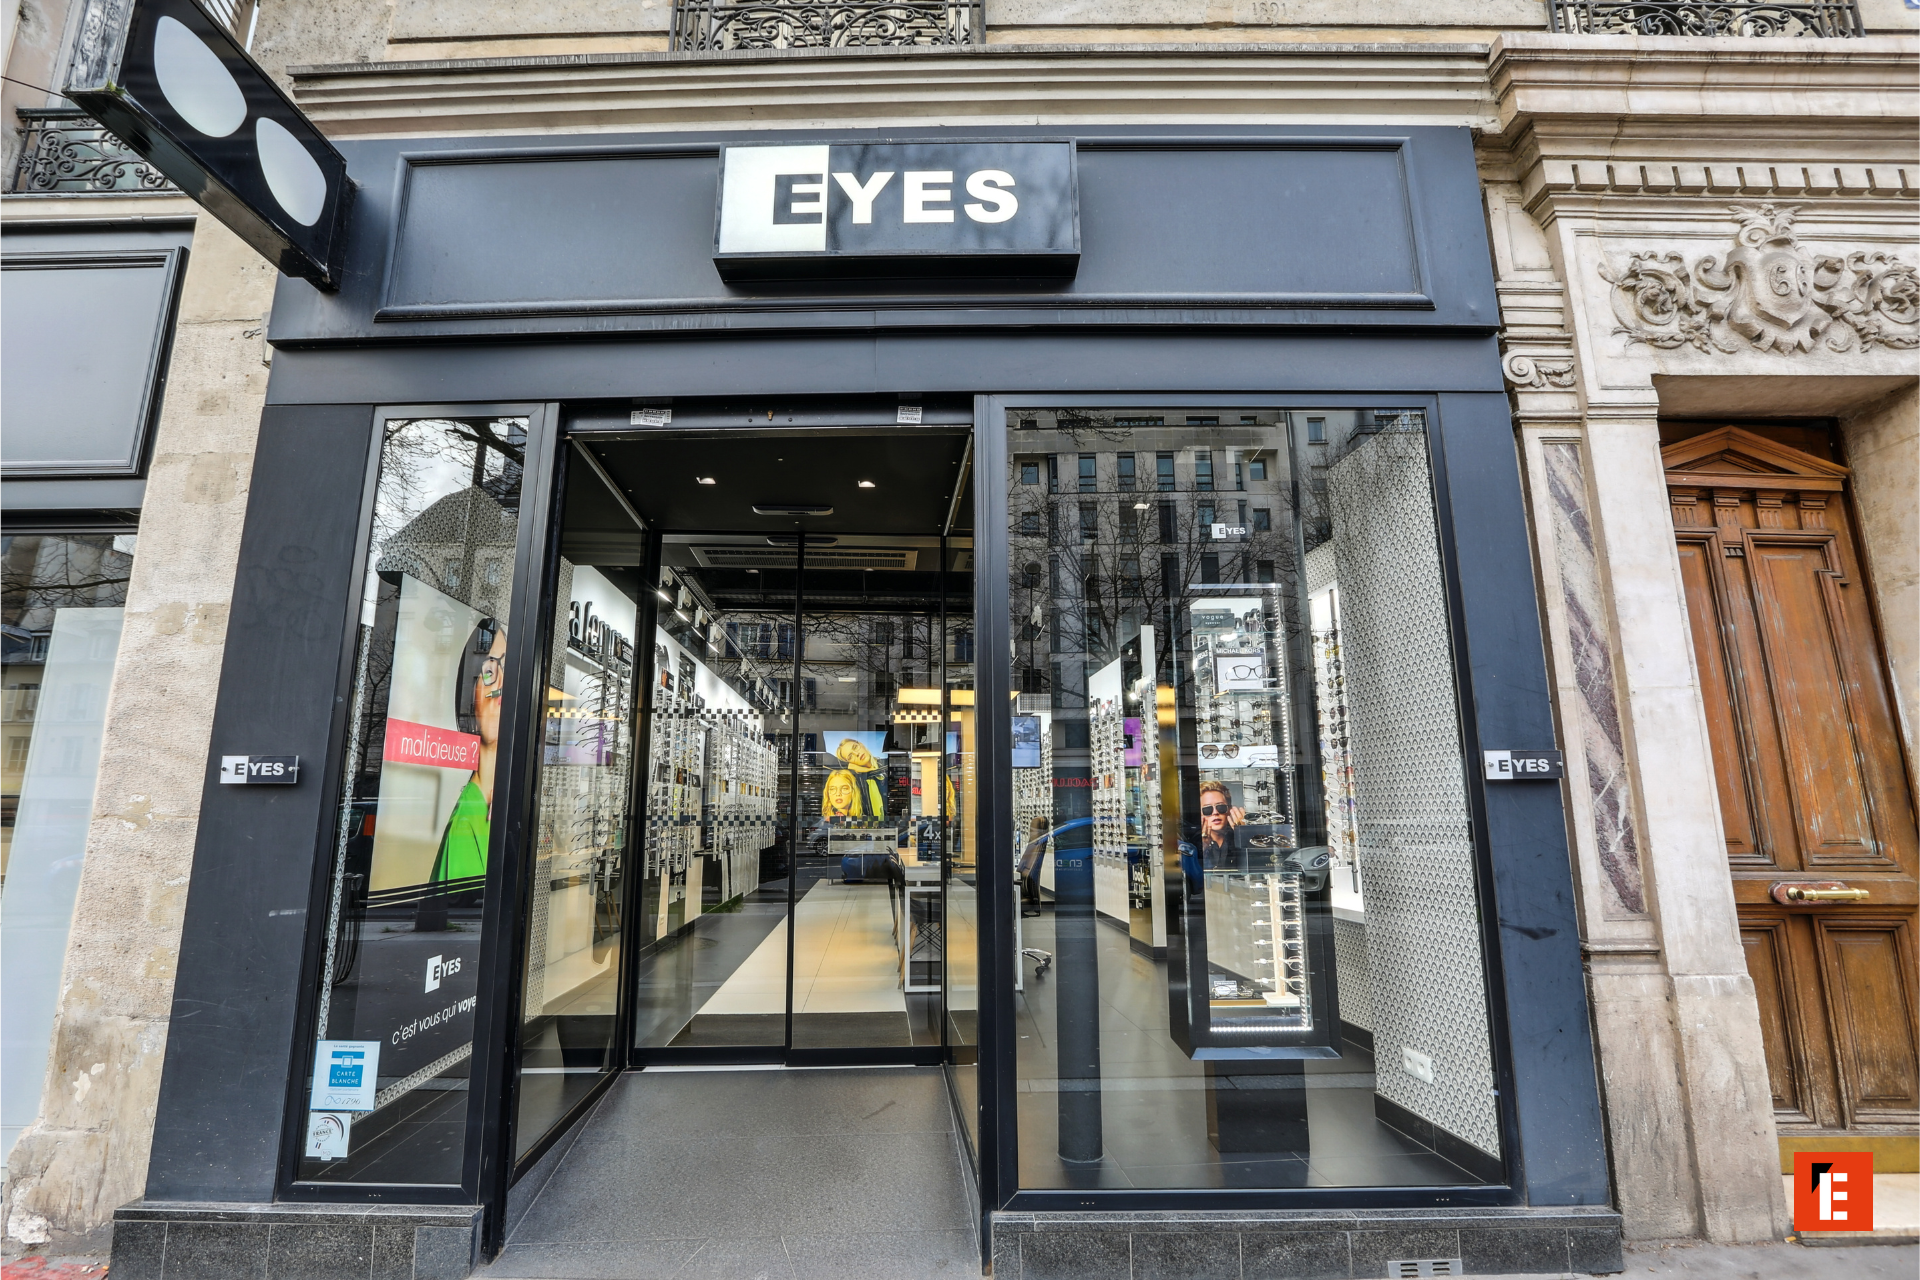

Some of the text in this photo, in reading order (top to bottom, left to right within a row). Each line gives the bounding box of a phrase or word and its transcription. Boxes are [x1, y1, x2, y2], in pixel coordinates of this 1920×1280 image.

[773, 169, 1019, 225] EYES
[1218, 526, 1246, 535] EYES
[400, 728, 467, 762] malicieuse
[234, 762, 284, 776] EYES
[1498, 758, 1549, 773] EYES
[432, 957, 462, 982] EYES
[391, 1018, 418, 1045] c'est
[419, 1011, 441, 1032] vous
[442, 1000, 457, 1024] qui
